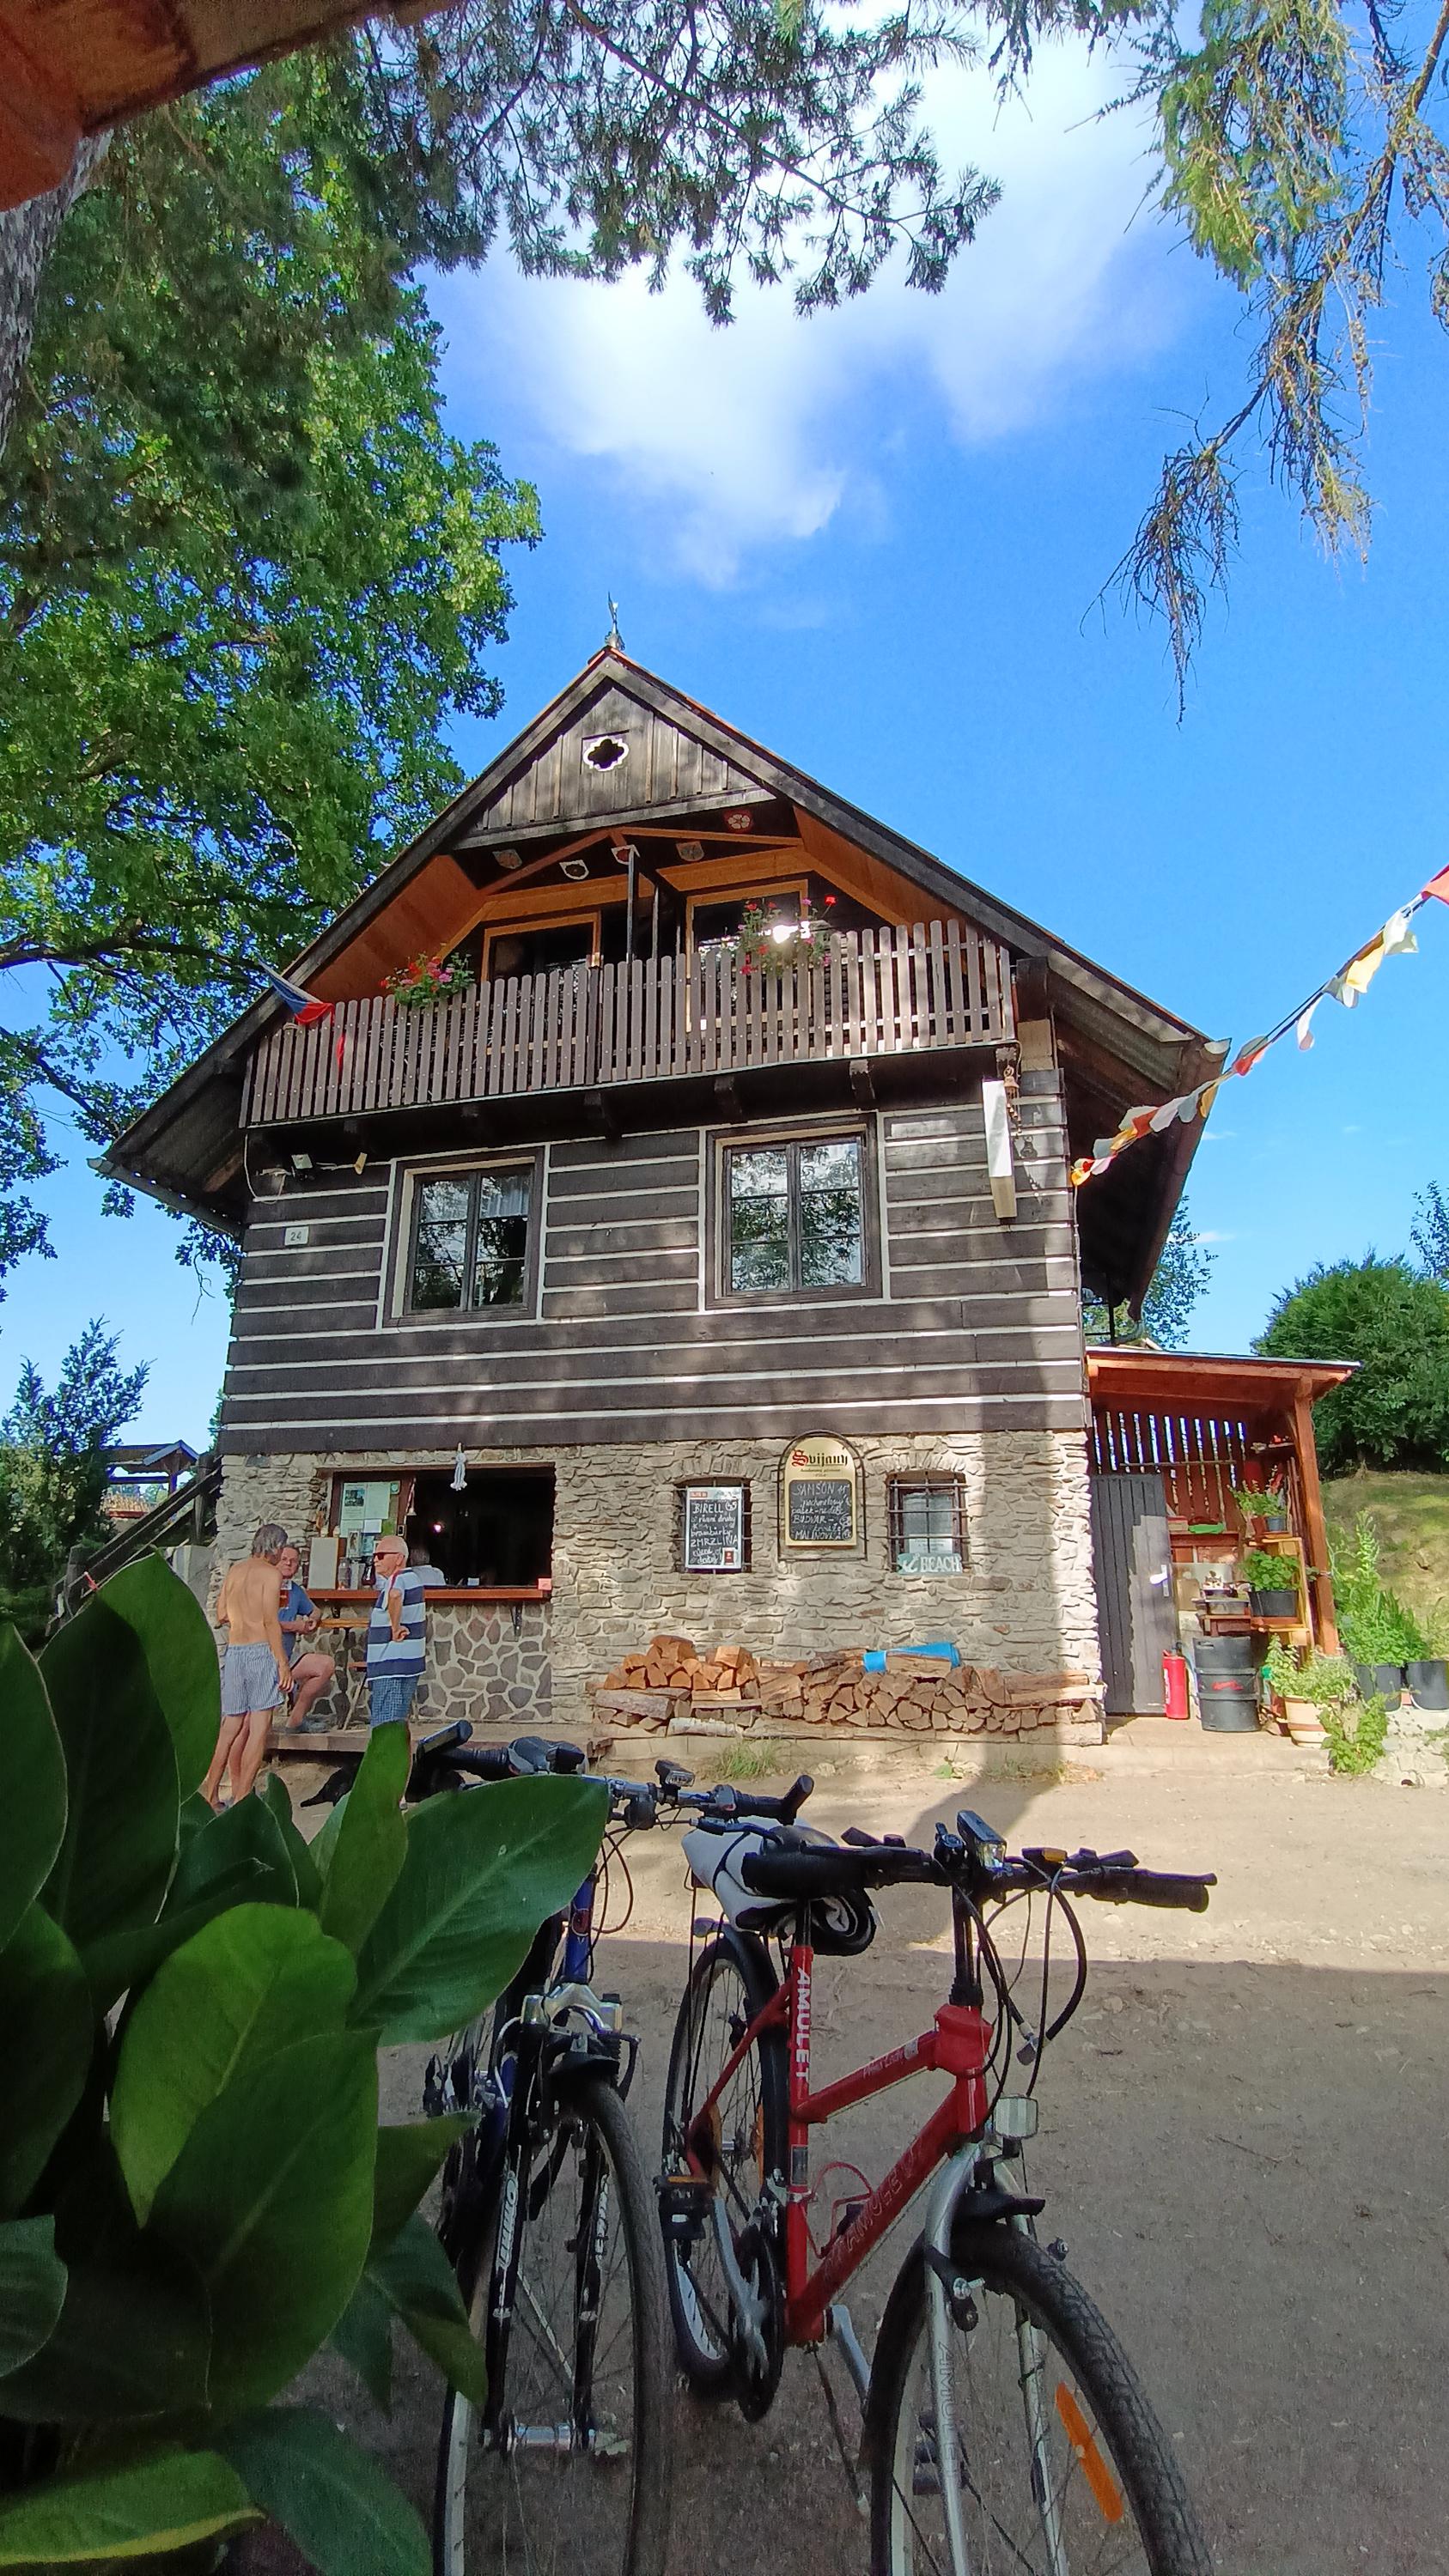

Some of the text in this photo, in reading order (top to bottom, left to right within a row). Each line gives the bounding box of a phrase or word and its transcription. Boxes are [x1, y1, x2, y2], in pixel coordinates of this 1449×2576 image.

[290, 1231, 301, 1242] 24
[792, 1449, 848, 1467] Svijany
[692, 1503, 723, 1514] BIRELL
[920, 1555, 960, 1573] BEACH
[796, 1966, 811, 2082] AMULET
